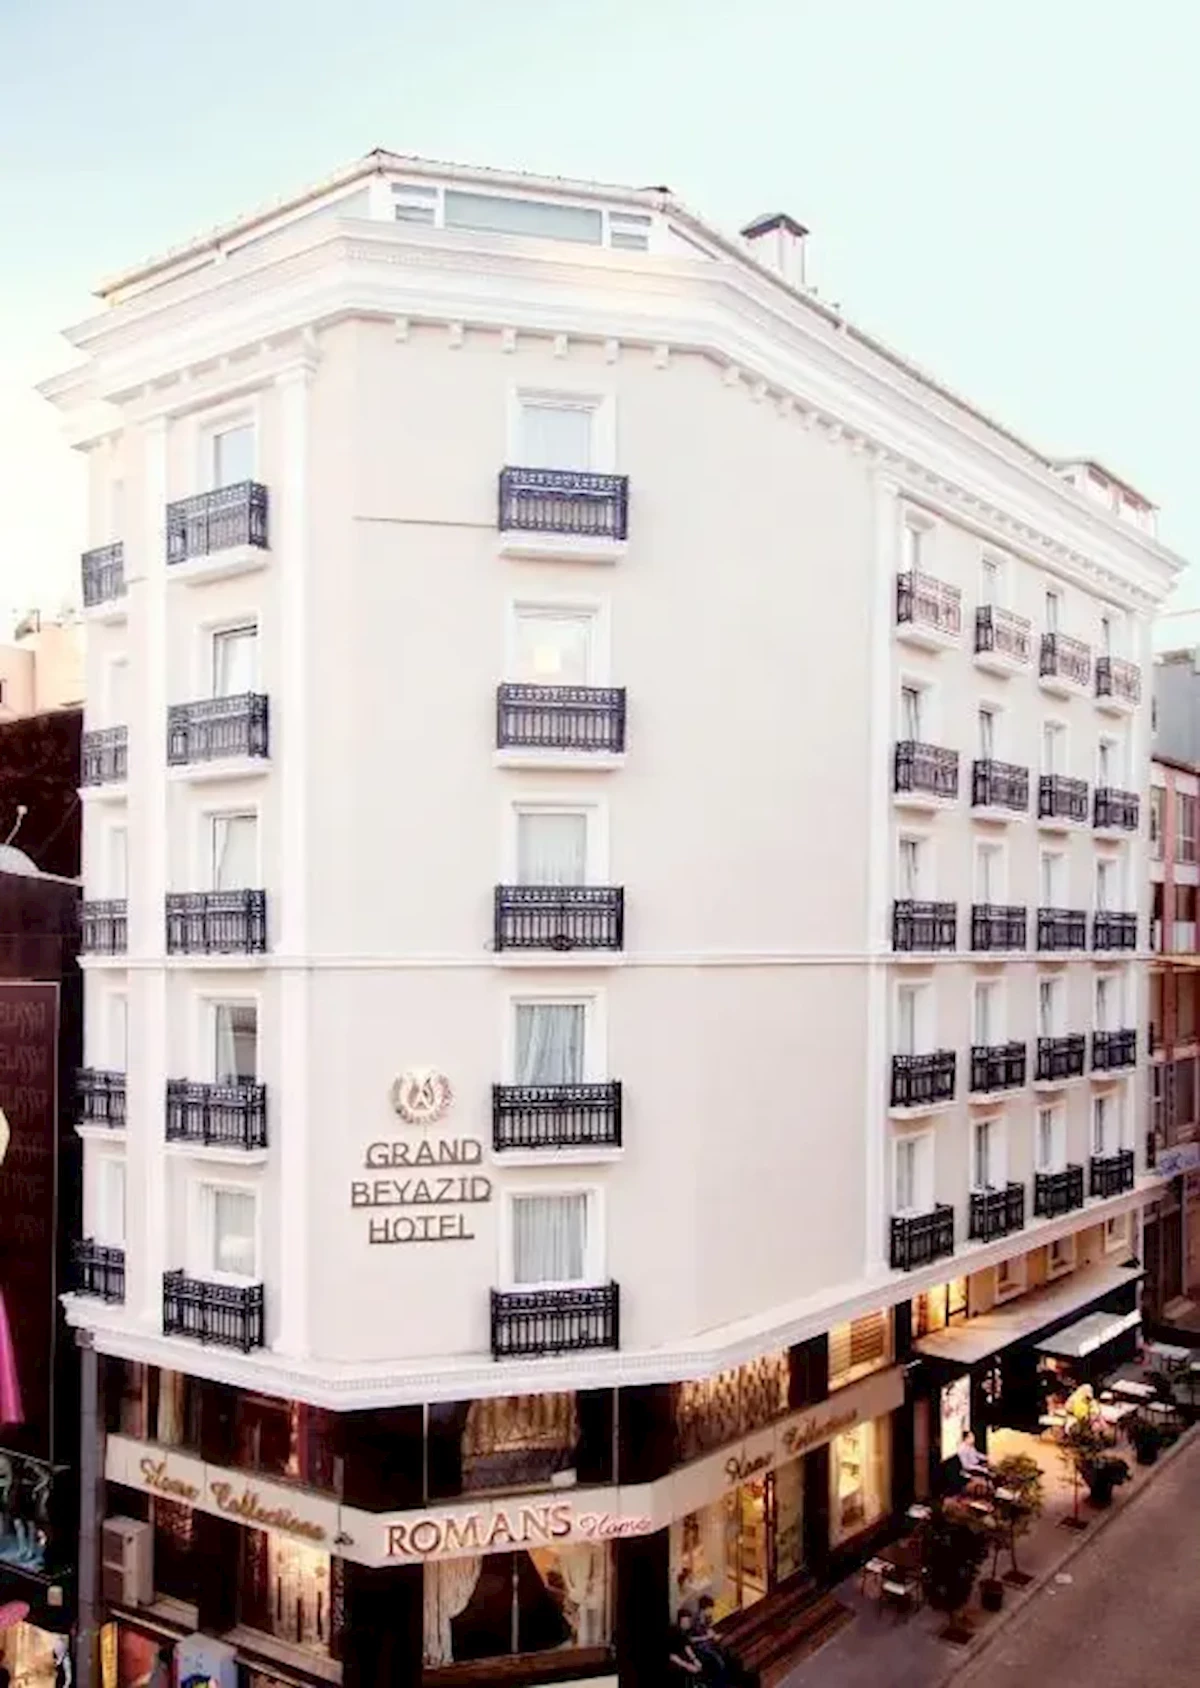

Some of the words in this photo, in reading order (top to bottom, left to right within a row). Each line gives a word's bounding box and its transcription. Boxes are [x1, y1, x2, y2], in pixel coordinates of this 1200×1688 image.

[366, 1139, 482, 1168] GRAND
[352, 1176, 491, 1207] BEYAZID
[369, 1214, 475, 1244] HOTEL
[385, 1502, 572, 1557] ROMANS
[579, 1514, 651, 1538] Home
